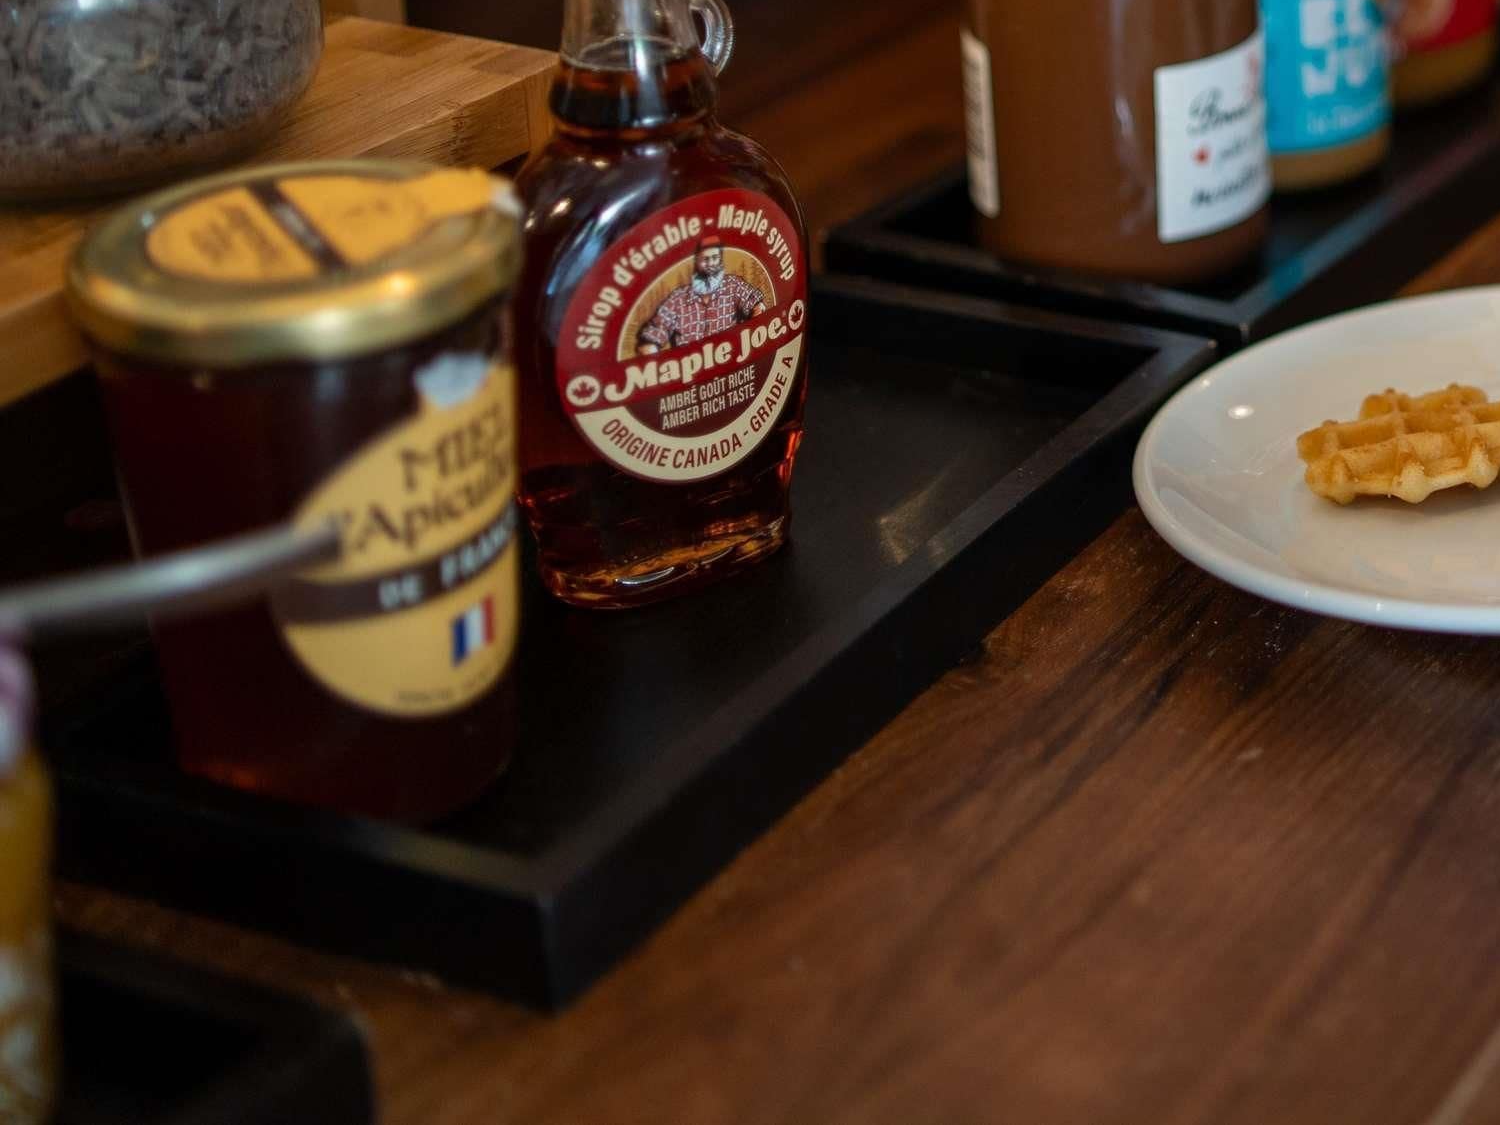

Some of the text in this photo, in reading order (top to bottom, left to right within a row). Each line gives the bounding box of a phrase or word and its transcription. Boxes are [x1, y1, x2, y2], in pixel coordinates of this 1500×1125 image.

[576, 286, 622, 349] Sirop
[613, 215, 701, 286] d'érable
[717, 204, 768, 235] Maple
[766, 228, 797, 280] syrup
[604, 316, 787, 402] Maple Joe
[659, 365, 756, 413] AMBRÉ GOÛT RICHE
[602, 419, 671, 467] ORIGINE
[672, 433, 742, 469] CANADA
[750, 372, 788, 433] GRADE
[784, 355, 794, 368] A
[662, 382, 756, 430] AMBER RICH TASTE
